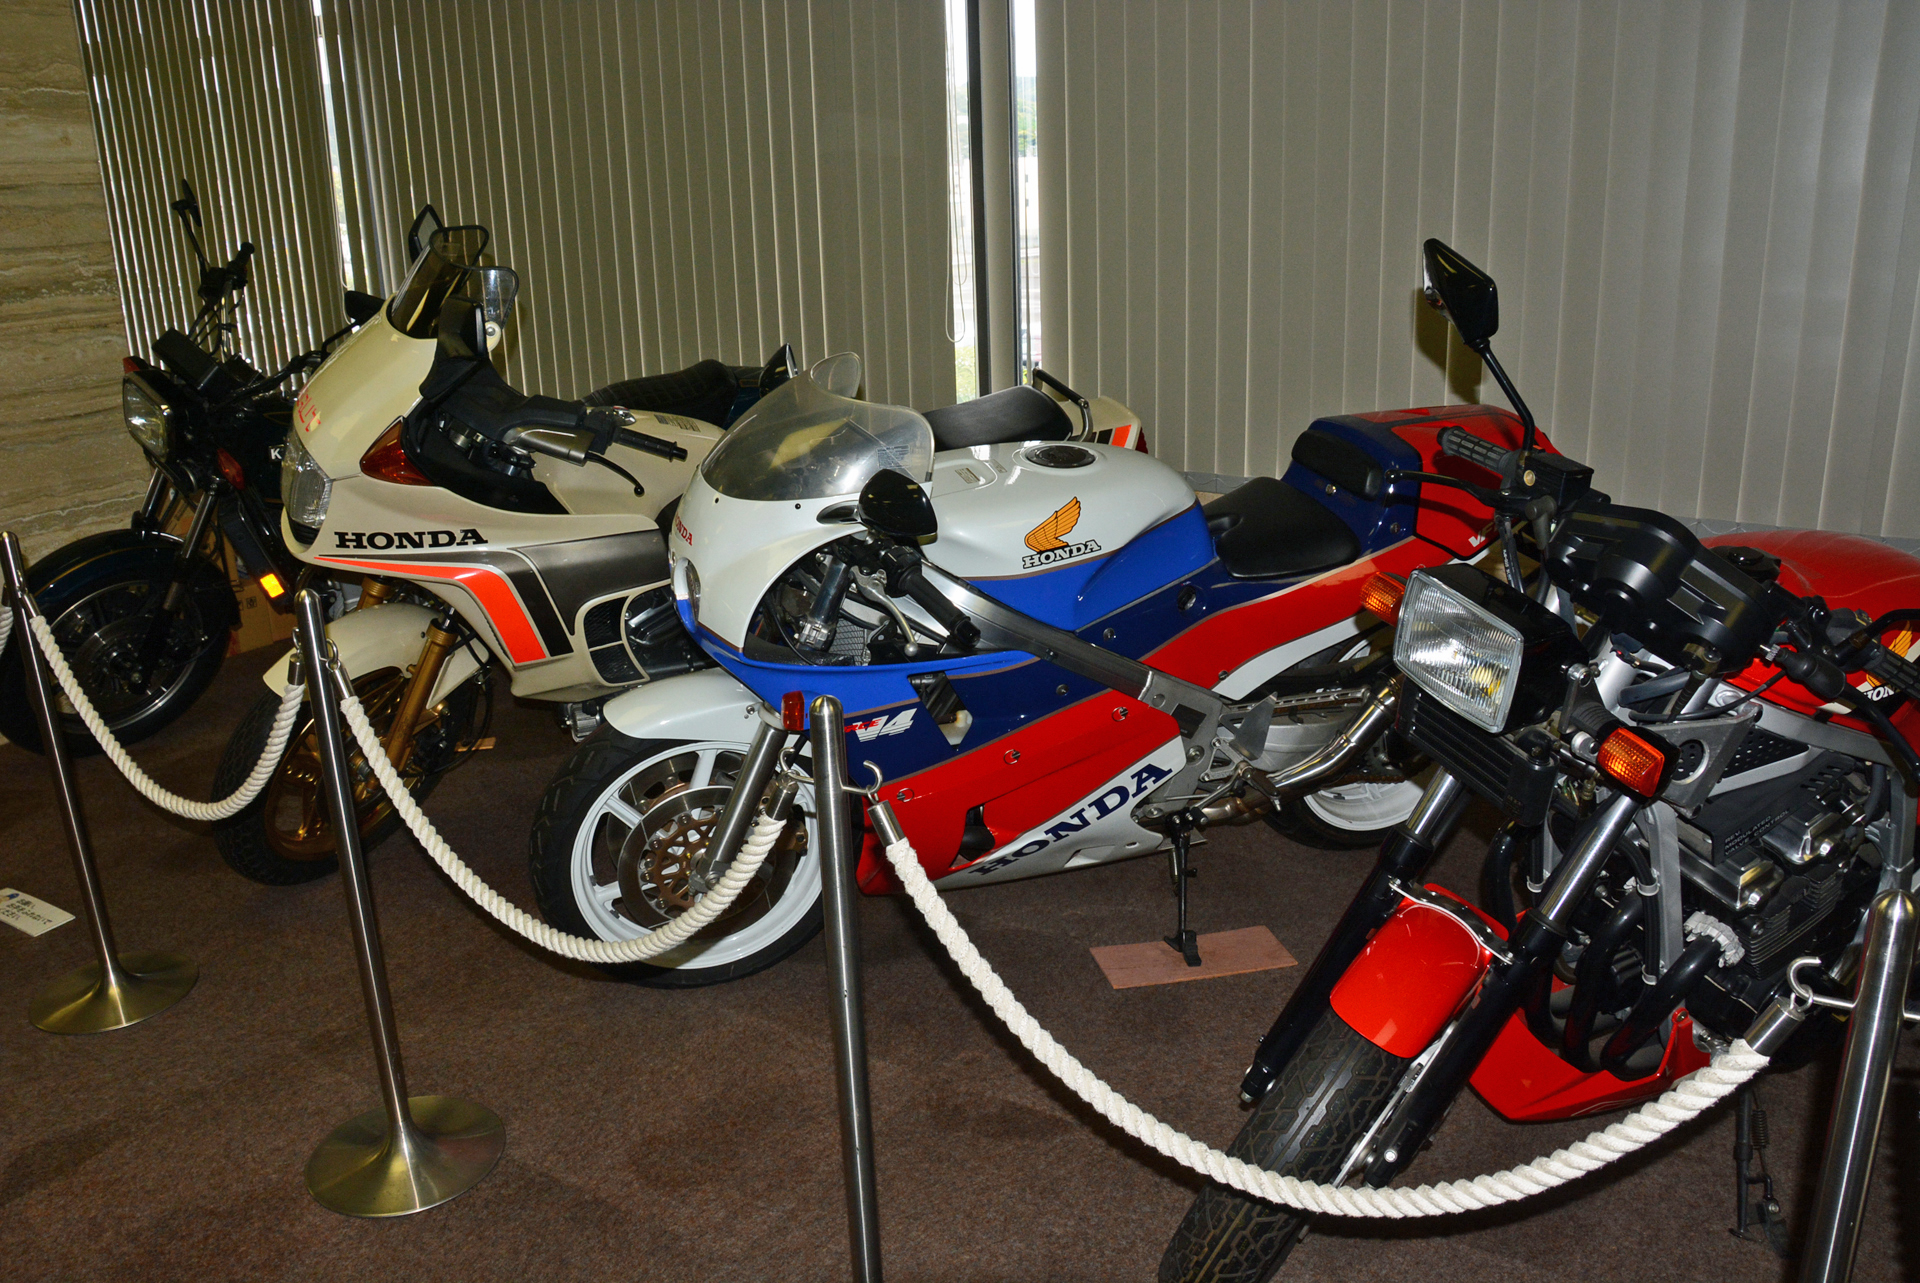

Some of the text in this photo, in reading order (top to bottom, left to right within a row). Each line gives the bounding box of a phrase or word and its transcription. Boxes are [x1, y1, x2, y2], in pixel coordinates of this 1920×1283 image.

[334, 528, 489, 550] HONDA
[1022, 539, 1102, 569] HONDA
[968, 763, 1174, 876] HONDA
[1724, 815, 1772, 851] MODULATED
[1724, 810, 1789, 856] VALVE CONTROL
